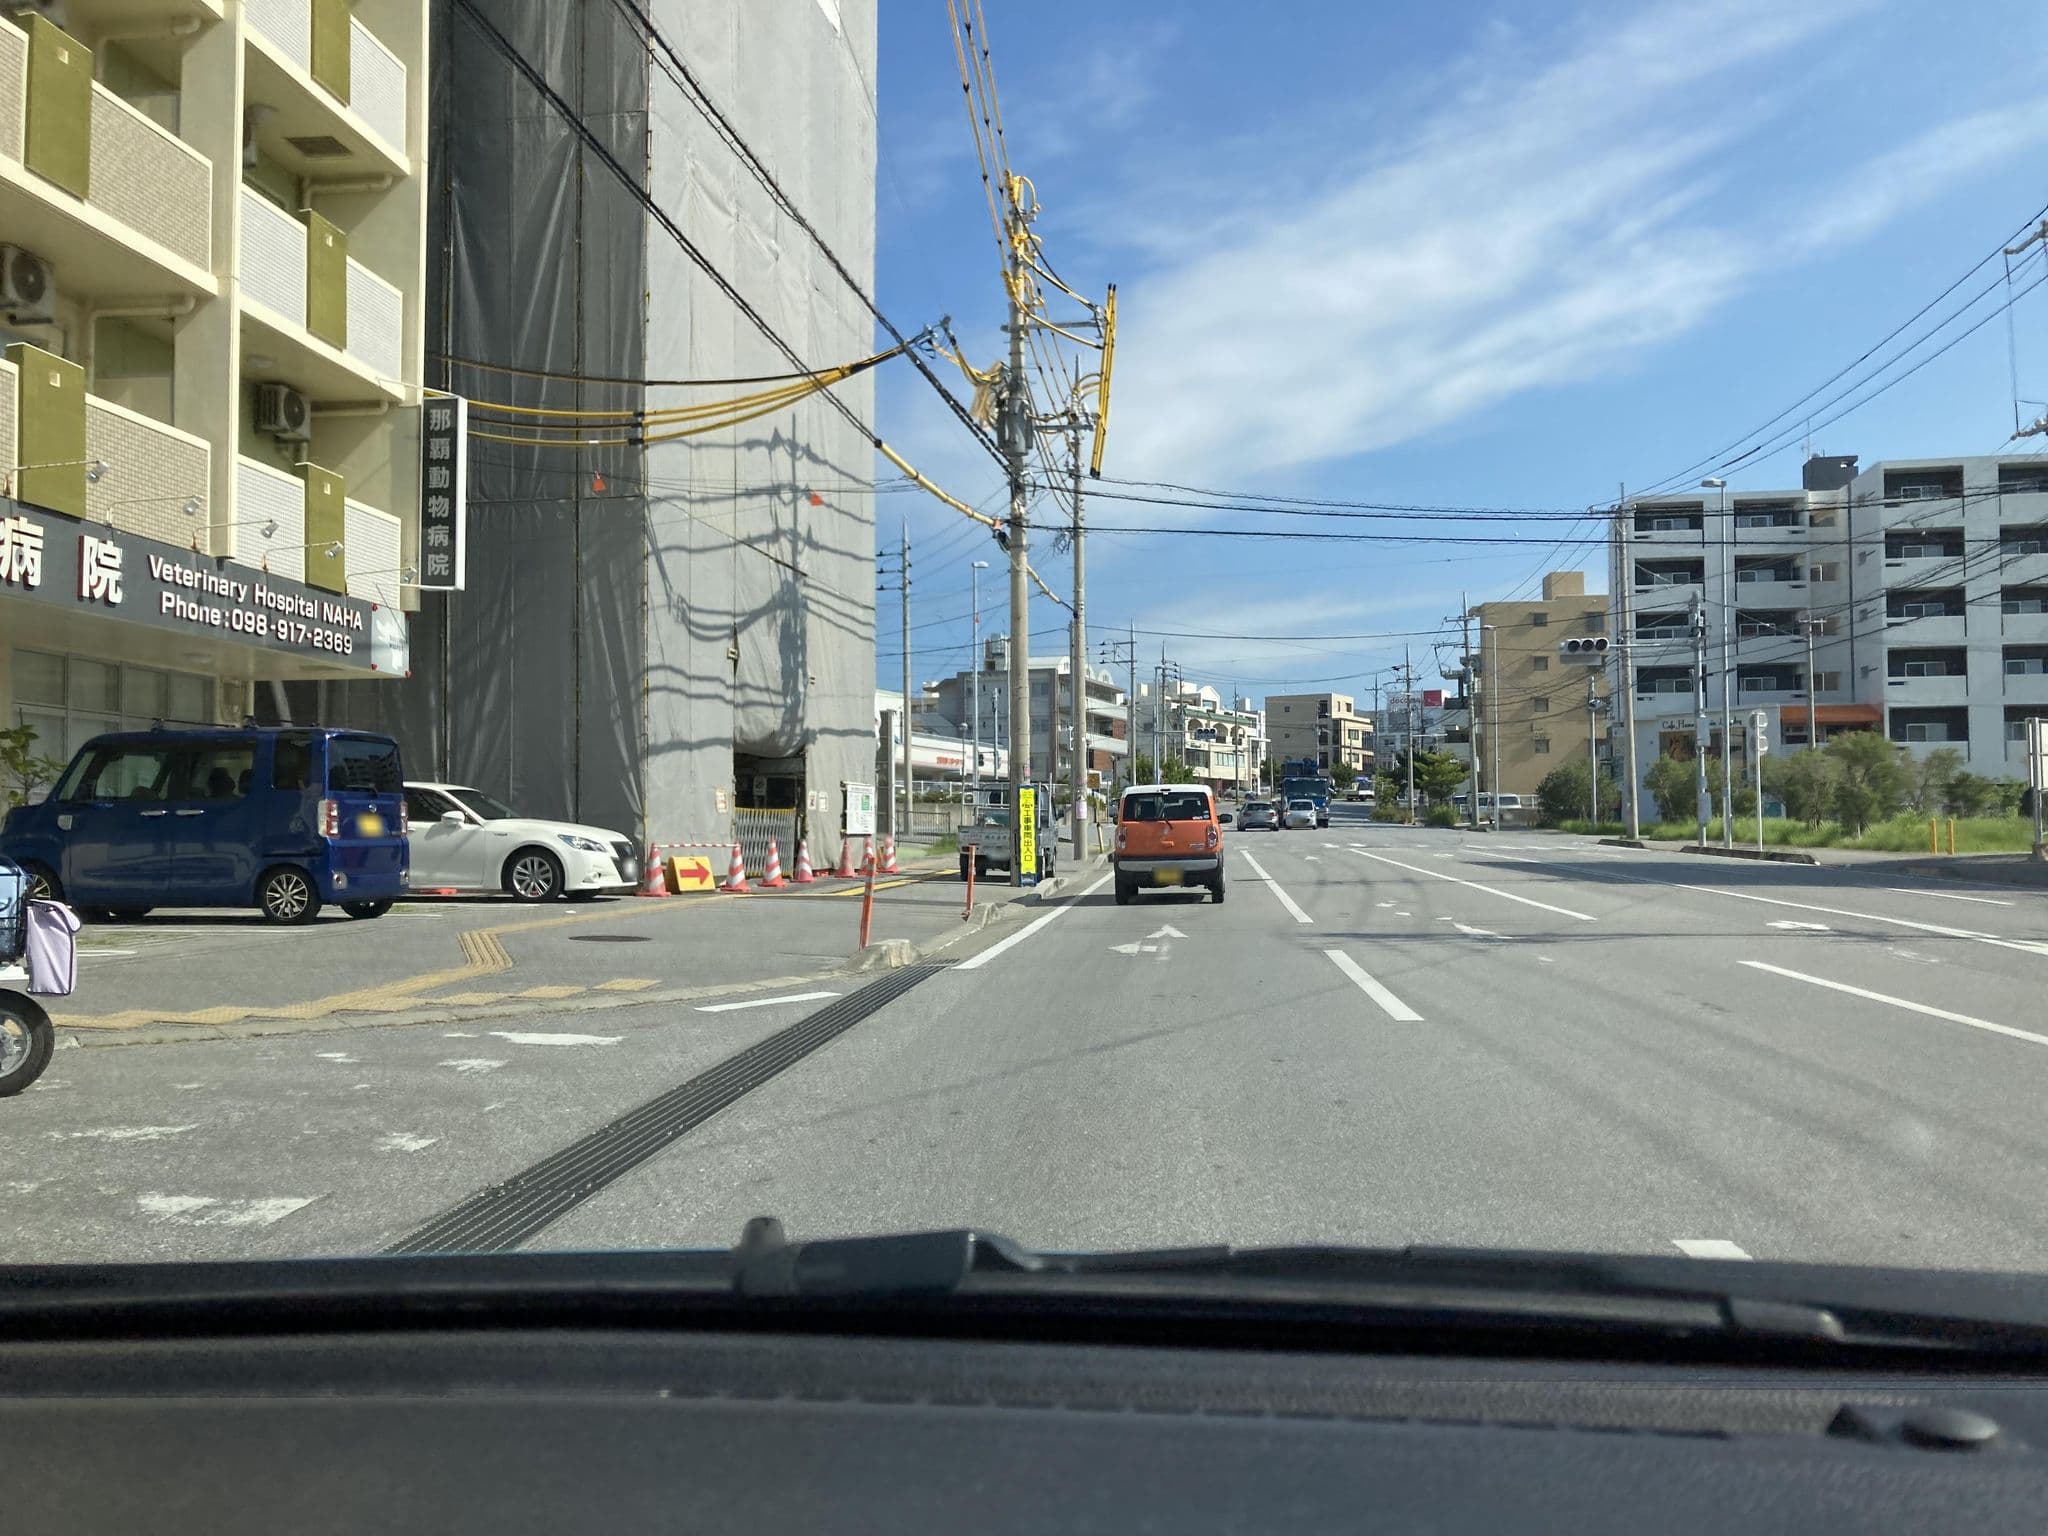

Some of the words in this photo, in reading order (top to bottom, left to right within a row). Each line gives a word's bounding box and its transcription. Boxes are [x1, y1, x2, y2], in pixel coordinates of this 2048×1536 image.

[427, 408, 451, 577] 那覇動物病院
[148, 554, 248, 603] Veterinary
[254, 583, 318, 619] Hospital
[322, 602, 363, 631] NAHA
[1023, 809, 1033, 862] 工事車両出入口
